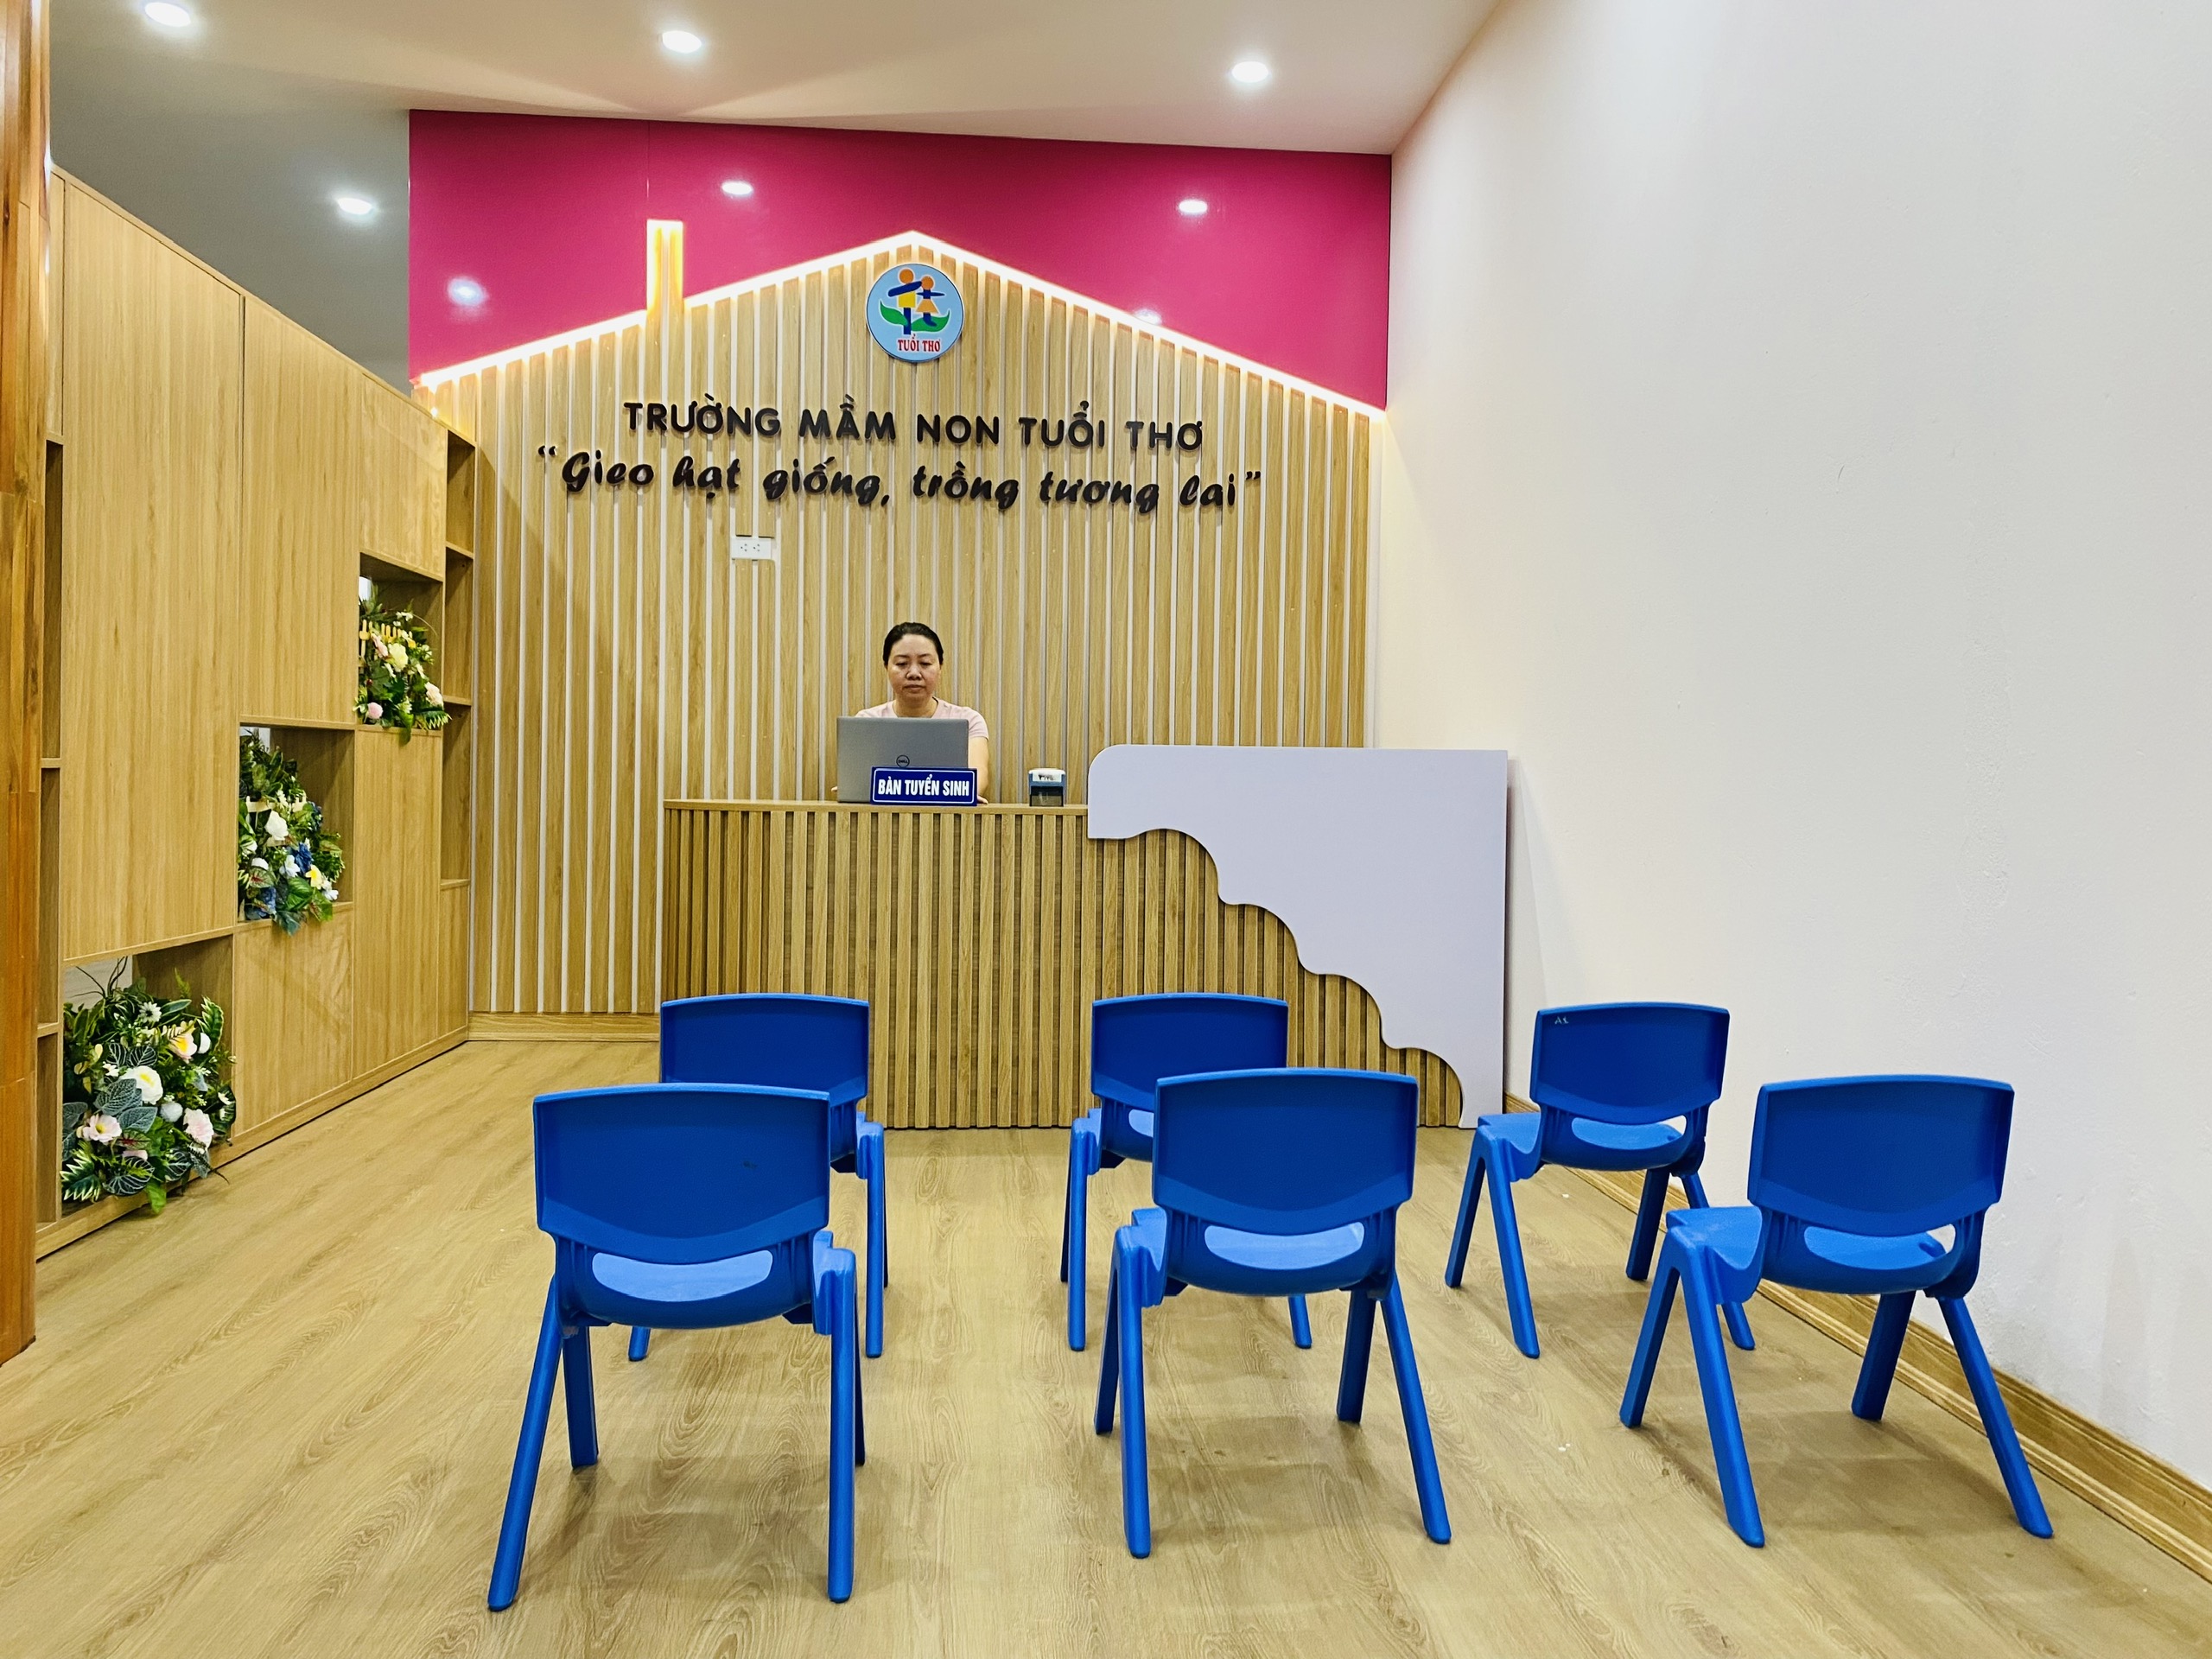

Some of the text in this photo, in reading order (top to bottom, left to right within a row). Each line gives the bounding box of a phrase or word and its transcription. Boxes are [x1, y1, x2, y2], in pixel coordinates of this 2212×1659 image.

[898, 334, 940, 352] TUỔI THƠ
[623, 393, 1203, 451] TRƯỜNG MẦM NON TUỔI THƠ
[672, 455, 741, 499] hạt
[762, 456, 890, 506] giống,
[912, 461, 1019, 510] trồng
[1039, 471, 1159, 514] tương
[878, 773, 969, 796] BÀN TUYỂN SINH
